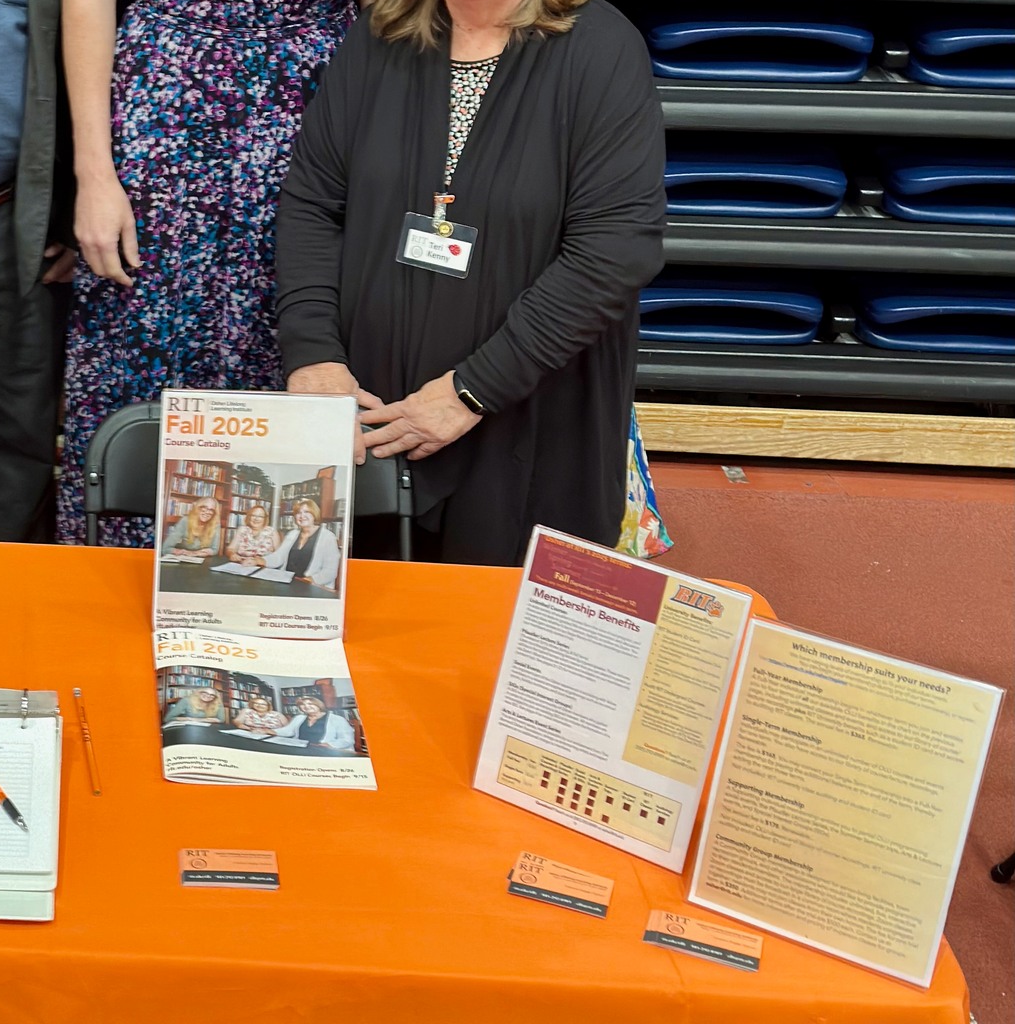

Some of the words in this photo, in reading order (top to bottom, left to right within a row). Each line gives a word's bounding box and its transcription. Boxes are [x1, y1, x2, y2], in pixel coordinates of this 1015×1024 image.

[168, 397, 204, 412] RIT
[167, 415, 204, 434] Fall
[212, 416, 269, 437] 2025
[165, 438, 195, 446] Course
[197, 439, 231, 449] Catalog
[554, 572, 570, 584] Fall
[671, 585, 715, 612] RIT
[187, 610, 213, 618] Learning
[534, 588, 596, 618] Membership
[598, 610, 641, 632] Benefits
[156, 616, 191, 625] Community
[157, 631, 192, 641] RIT
[157, 641, 195, 653] Fall
[203, 642, 259, 660] 2025
[792, 642, 818, 656] Which
[820, 651, 873, 674] membership
[875, 668, 895, 679] suits
[897, 674, 918, 686] your
[919, 681, 951, 695] needs?
[783, 676, 823, 694] Membership
[742, 714, 781, 731] Single-Term
[782, 726, 822, 745] Membership
[728, 778, 764, 796] Supporting
[765, 790, 805, 809] Membership
[523, 852, 547, 865] RIT
[716, 833, 751, 852] Community
[752, 846, 773, 859] Group
[773, 853, 814, 872] Membership
[519, 862, 544, 874] RIT
[665, 913, 690, 925] RIT
